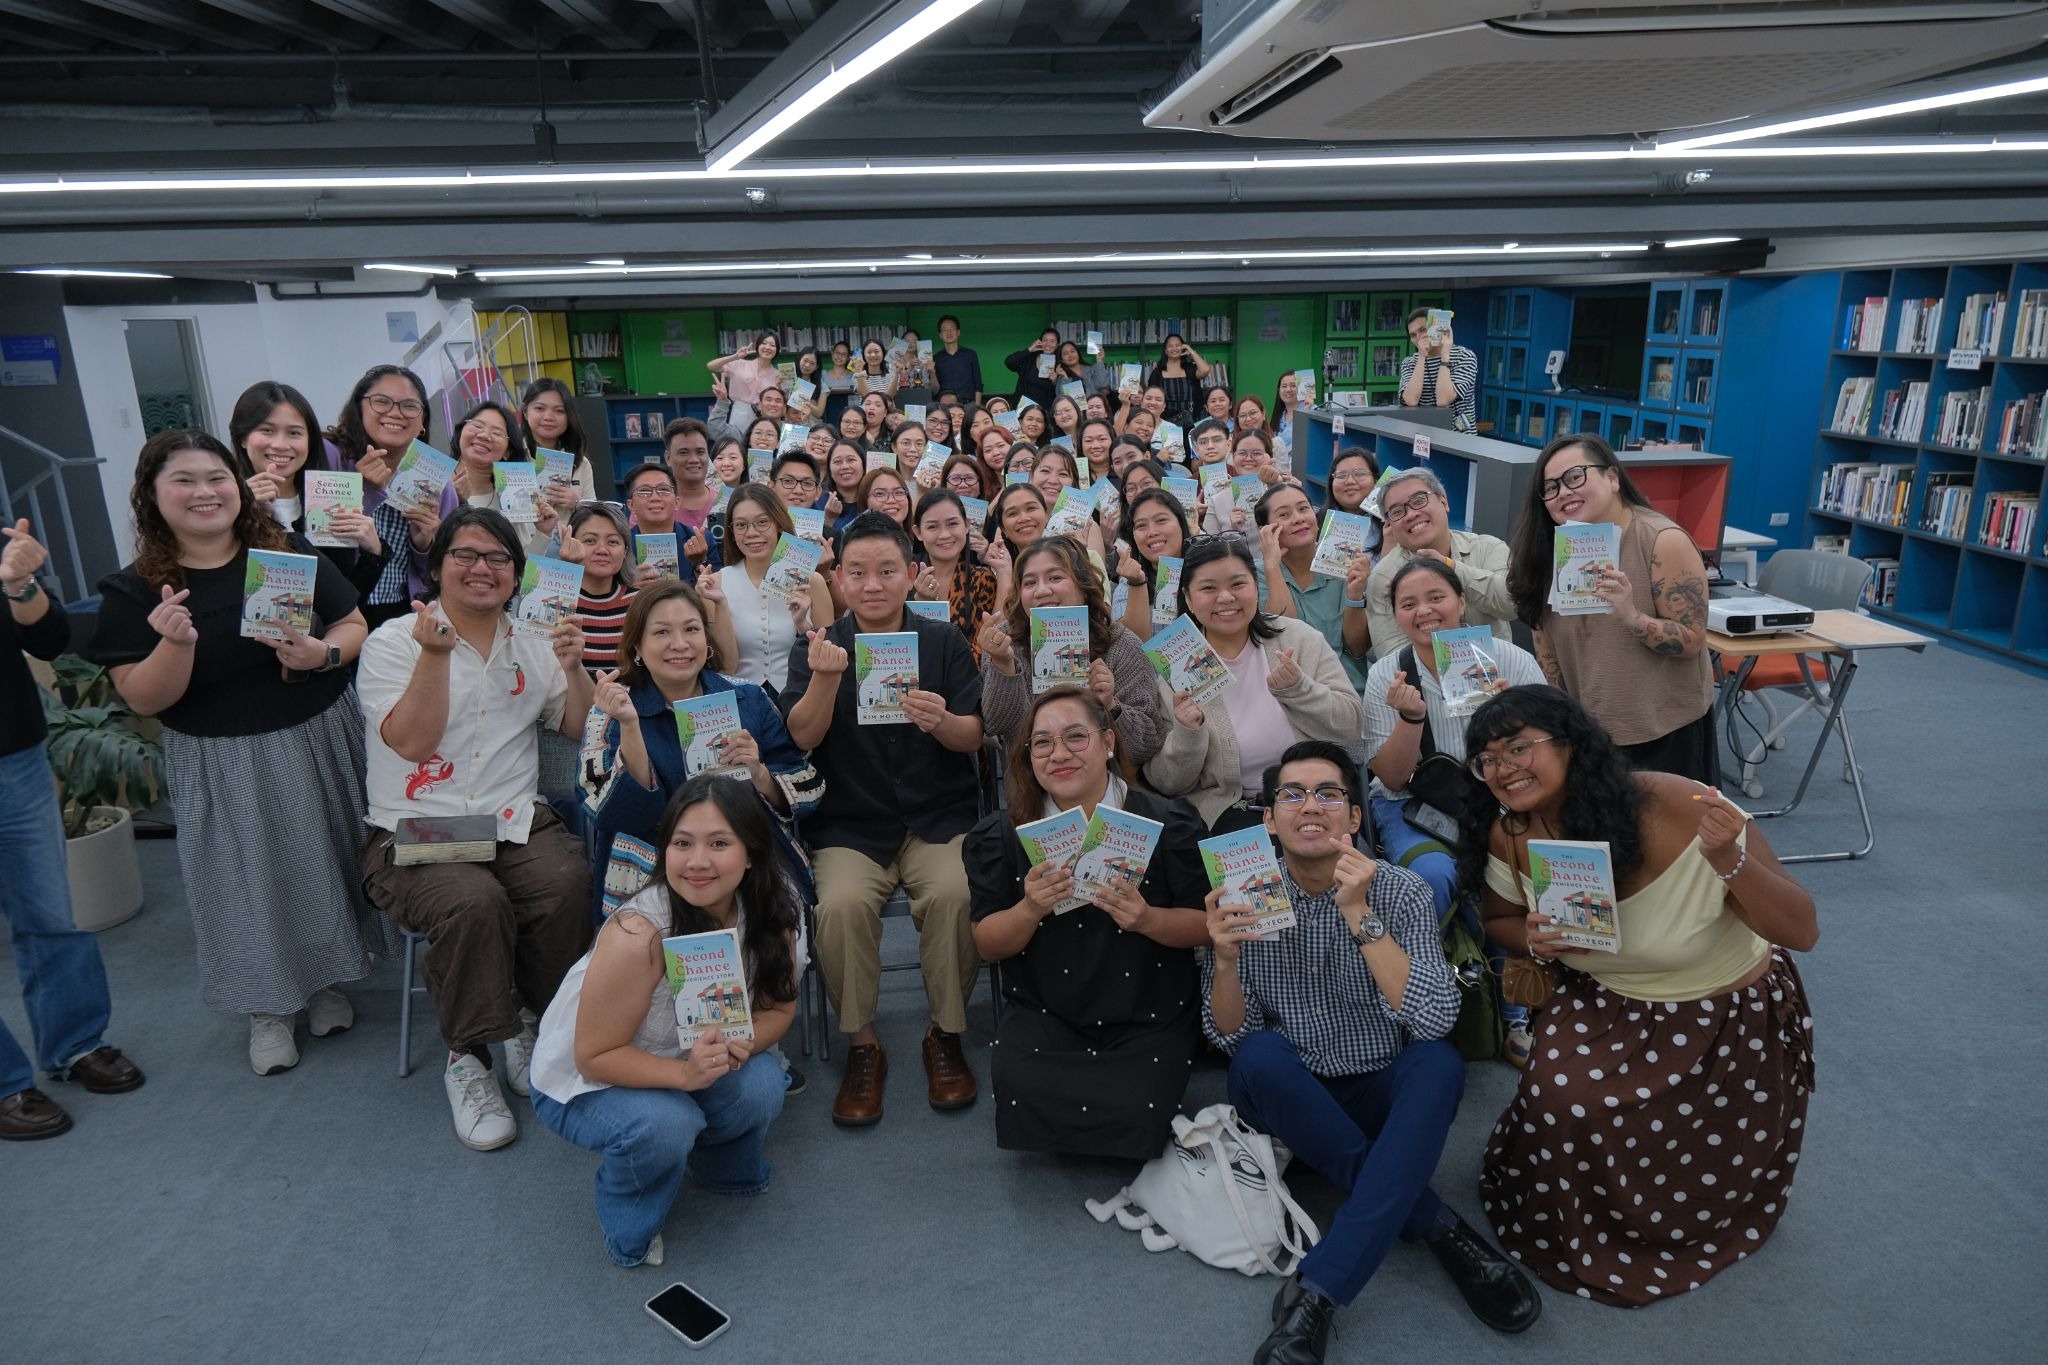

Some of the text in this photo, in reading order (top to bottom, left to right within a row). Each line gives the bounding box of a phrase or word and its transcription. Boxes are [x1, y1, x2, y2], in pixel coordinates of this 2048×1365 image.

[315, 488, 352, 496] Chance
[317, 480, 350, 489] Second
[1566, 536, 1606, 545] Second
[785, 542, 814, 560] Second
[1563, 545, 1608, 554] Chance
[260, 564, 306, 577] Second
[256, 574, 307, 587] Chance
[1041, 618, 1081, 628] Second
[1039, 628, 1083, 638] Chance
[1154, 628, 1189, 656] Second
[867, 646, 909, 655] Second
[1160, 635, 1196, 666] Chance
[864, 655, 912, 665] Chance
[1201, 678, 1230, 701] HO-YEON
[687, 704, 729, 721] Second
[879, 712, 909, 720] HO-YEO
[685, 722, 737, 739] CONVENIENCE STORE
[686, 715, 733, 732] Chance
[1032, 823, 1078, 847] Second
[1101, 821, 1148, 843] Second
[1034, 834, 1084, 857] Chance
[1089, 840, 1127, 855] CONVENIENCE
[1128, 850, 1146, 860] STORE
[1095, 831, 1146, 854] Chance
[1213, 840, 1260, 862] Second
[1214, 853, 1266, 874] Chance
[1542, 857, 1595, 870] Second
[1214, 862, 1272, 882] CONVENIENCE STORE
[1541, 868, 1600, 883] Chance
[1540, 880, 1604, 891] CONVENIENCE STORE
[1057, 900, 1072, 910] KIM
[1250, 916, 1290, 930] HO-YEON
[1567, 934, 1612, 946] HO-YEON
[676, 948, 726, 964] Second
[675, 961, 731, 977] Chance
[673, 972, 735, 983] CONVENIENCE STORE
